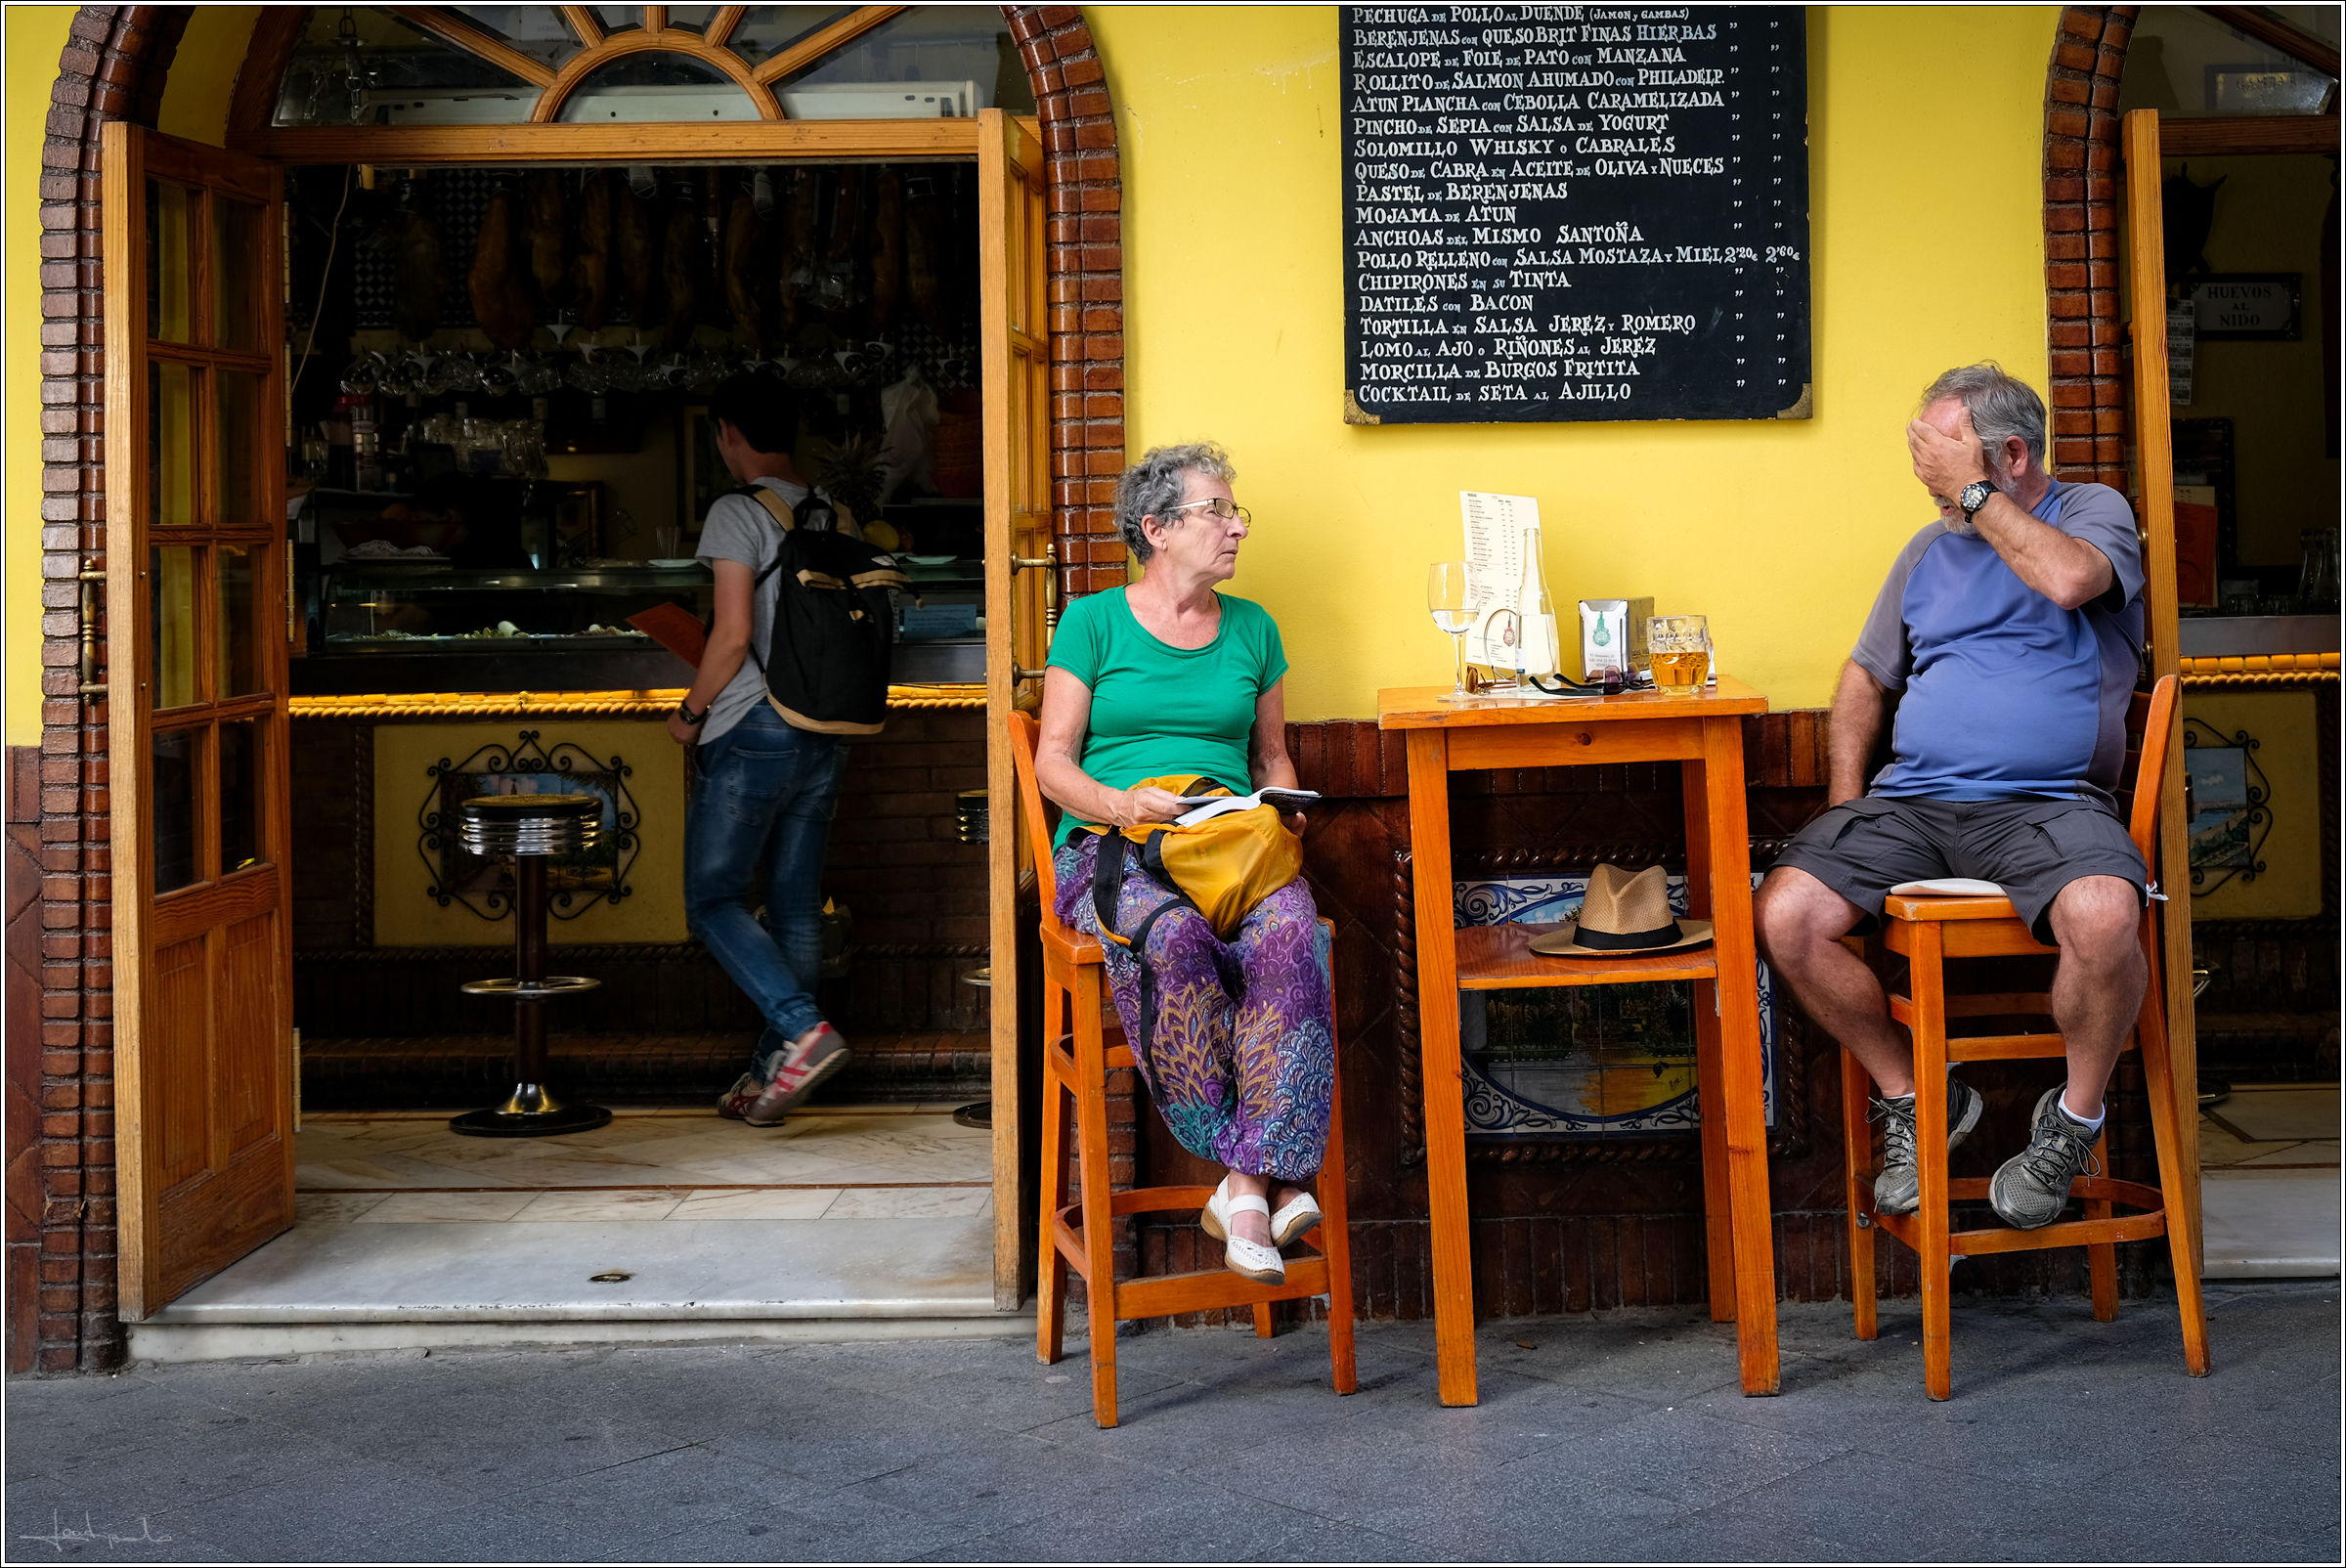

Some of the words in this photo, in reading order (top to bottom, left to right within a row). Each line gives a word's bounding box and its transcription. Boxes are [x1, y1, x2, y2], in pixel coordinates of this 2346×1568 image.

[1353, 8, 1429, 24] PECHUGA
[1450, 6, 1503, 23] POLLO
[1520, 6, 1584, 22] DUENDE
[1354, 28, 1460, 49] BERENJENAS
[1581, 23, 1631, 43] FINAS
[1636, 23, 1716, 43] HIERBAS
[1353, 50, 1441, 69] ESCALOPE
[1462, 48, 1502, 67] FOIE
[1524, 49, 1569, 65] PATO
[1596, 47, 1686, 65] MANZANA
[1354, 73, 1433, 94] ROLLITO
[1452, 71, 1524, 90] SALMON
[1527, 70, 1614, 87] AHUMADO
[1637, 67, 1724, 87] PHILADELP.
[1350, 96, 1398, 113] ATUN
[1402, 95, 1480, 112] PLANCHA
[1503, 93, 1581, 111] CEBOLLA
[1587, 91, 1724, 111] CARAMELIZADA
[1354, 118, 1417, 136] PINCHO
[1436, 115, 1492, 135] SEPIA
[1516, 114, 1576, 133] SALSA
[1598, 113, 1669, 134] YOGURT
[1354, 139, 1457, 158] SOLOMILLO
[1469, 139, 1554, 155] WHISKY
[1576, 136, 1675, 156] CABRALES
[1355, 162, 1410, 184] QUESO
[1430, 160, 1489, 182] CABRA
[1509, 159, 1573, 178] ACEITE
[1595, 158, 1648, 178] OLIVA
[1659, 157, 1723, 177] NUECES
[1356, 184, 1424, 203] PASTEL
[1446, 182, 1567, 204] BERENJENAS
[1355, 206, 1443, 224] MOJAMA
[1464, 205, 1516, 224] ATUN
[1354, 228, 1443, 247] ANCHOAS
[1472, 227, 1541, 244] MISMO
[1556, 221, 1644, 244] SANTOÑA
[1357, 251, 1412, 270] POLLO
[1415, 250, 1491, 271] RELLENO
[1513, 247, 1575, 266] SALSA
[1579, 247, 1664, 265] MOSTAZA
[1675, 246, 1722, 264] MIEL
[1359, 272, 1467, 294] CHIPIRONES
[1509, 270, 1572, 289] TINTA
[2207, 285, 2272, 298] HUEVOS
[1360, 295, 1438, 314] DATILES
[1469, 294, 1534, 311] BACON
[2233, 302, 2249, 311] AL
[1361, 316, 1449, 338] TORTILLA
[1473, 316, 1538, 335] SALSA
[1548, 315, 1605, 336] JEREZ
[1622, 314, 1695, 335] ROMERO
[2220, 314, 2260, 326] NIDO
[1361, 341, 1412, 359] LOMO
[1436, 340, 1473, 357] AJO
[1494, 335, 1575, 362] RIÑONES
[1600, 336, 1656, 358] JEREZ
[1360, 363, 1462, 383] MORCILLA
[1485, 361, 1557, 380] BURGOS
[1564, 358, 1640, 379] FRITITA
[1360, 384, 1452, 403] COCKTAIL
[1478, 384, 1528, 402] SETA
[1558, 381, 1630, 401] AJILLO
